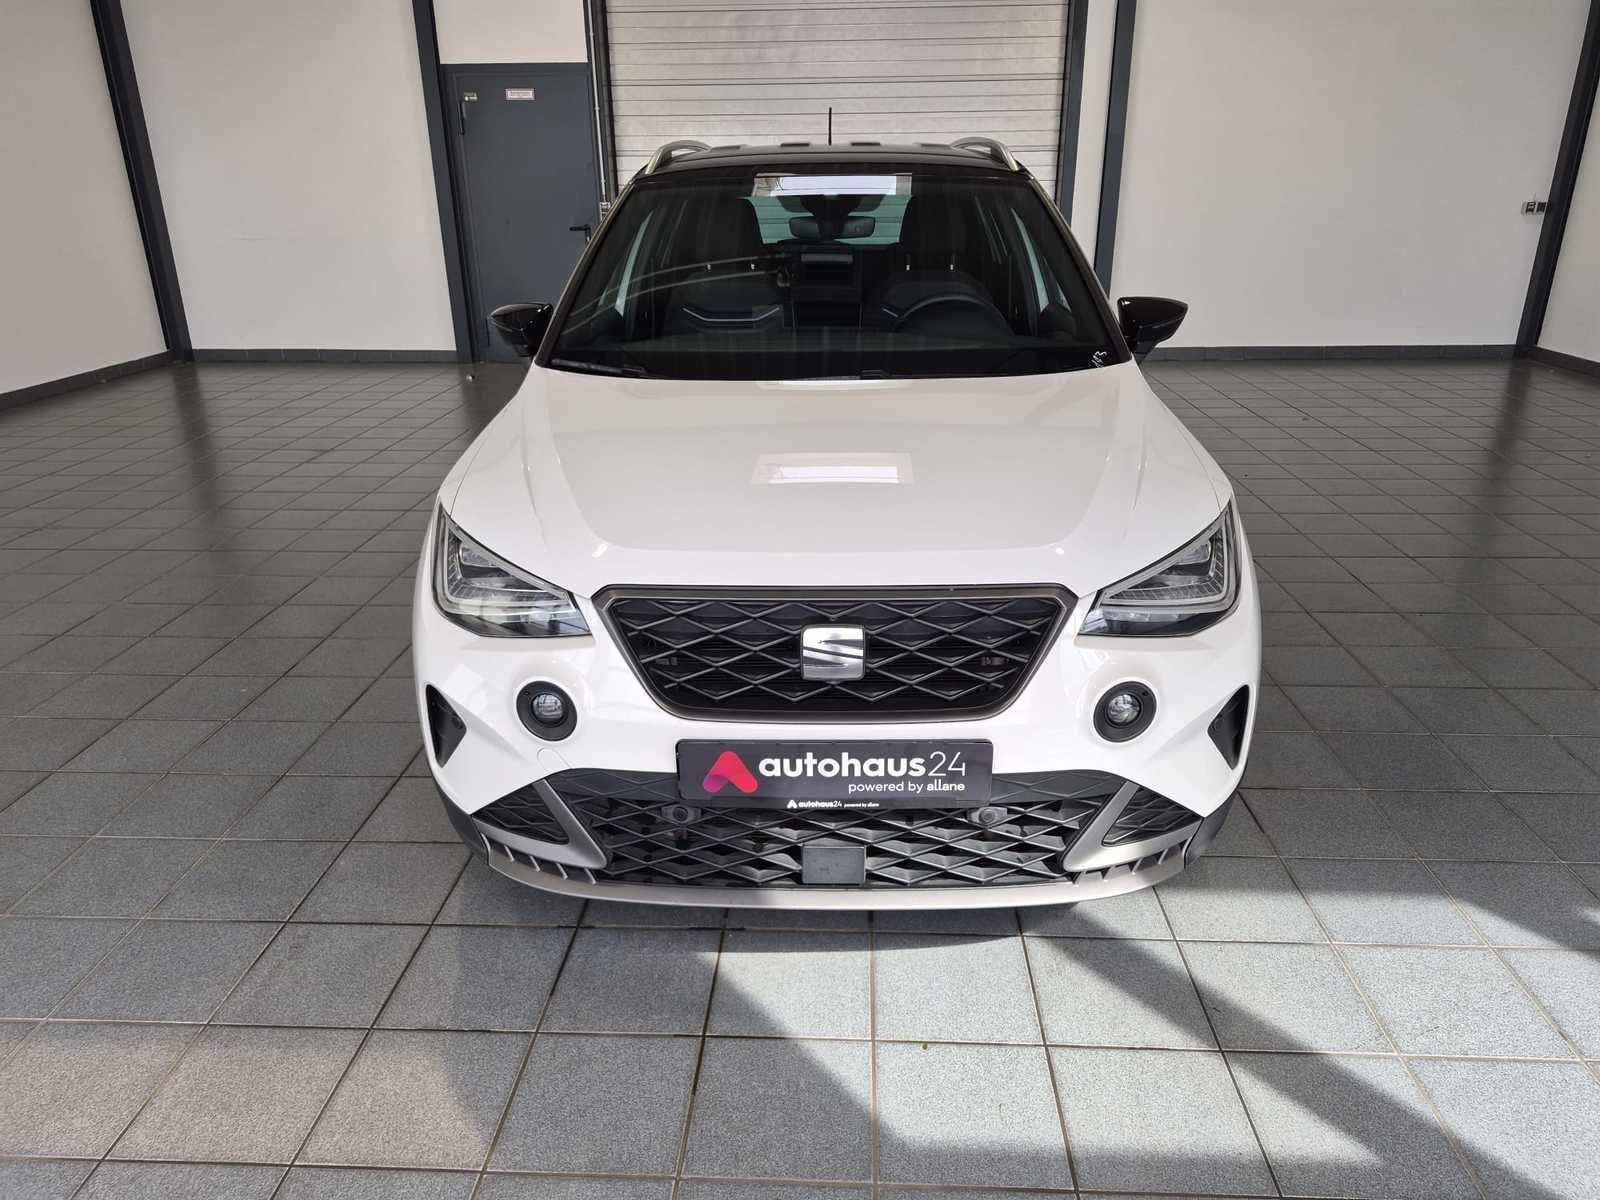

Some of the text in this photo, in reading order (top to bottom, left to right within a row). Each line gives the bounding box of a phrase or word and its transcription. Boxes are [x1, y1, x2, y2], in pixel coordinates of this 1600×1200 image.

[758, 751, 966, 777] autohaus24
[848, 779, 966, 794] powered by allane
[798, 800, 842, 808] autohaus24
